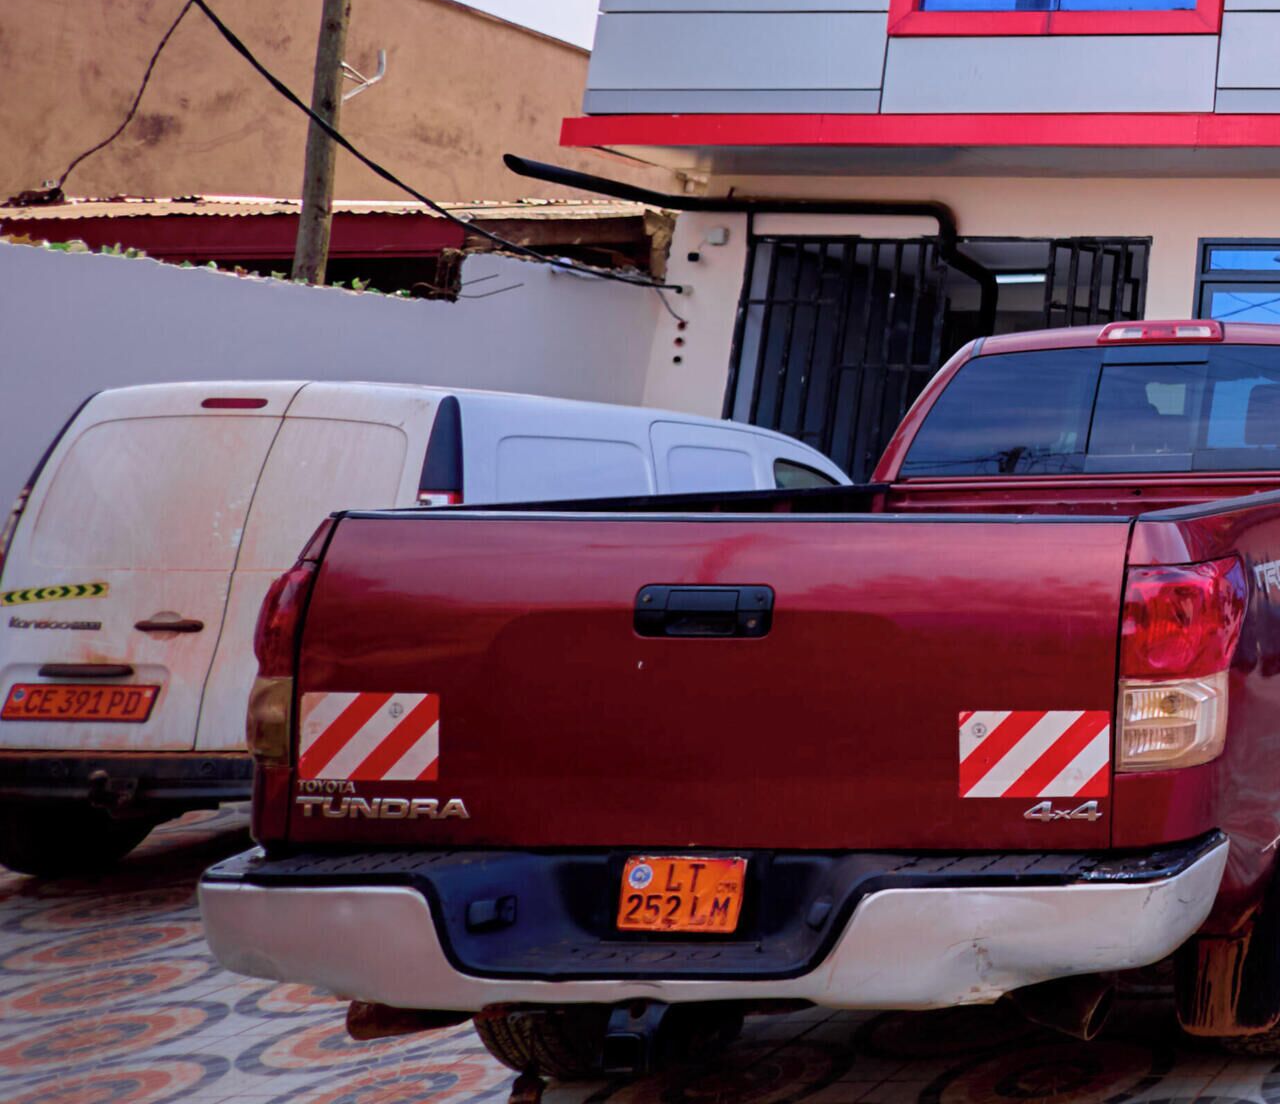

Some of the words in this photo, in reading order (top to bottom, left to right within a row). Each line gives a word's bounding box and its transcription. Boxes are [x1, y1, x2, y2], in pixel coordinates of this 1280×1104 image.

[24, 688, 58, 714] CE
[57, 689, 103, 715] 391
[106, 690, 142, 715] PD
[297, 779, 356, 794] TOYOTA
[295, 796, 471, 819] TUNDRA
[1023, 800, 1103, 822] 4x4
[665, 863, 707, 892] LT
[623, 894, 682, 925] 252
[688, 895, 731, 926] LM
